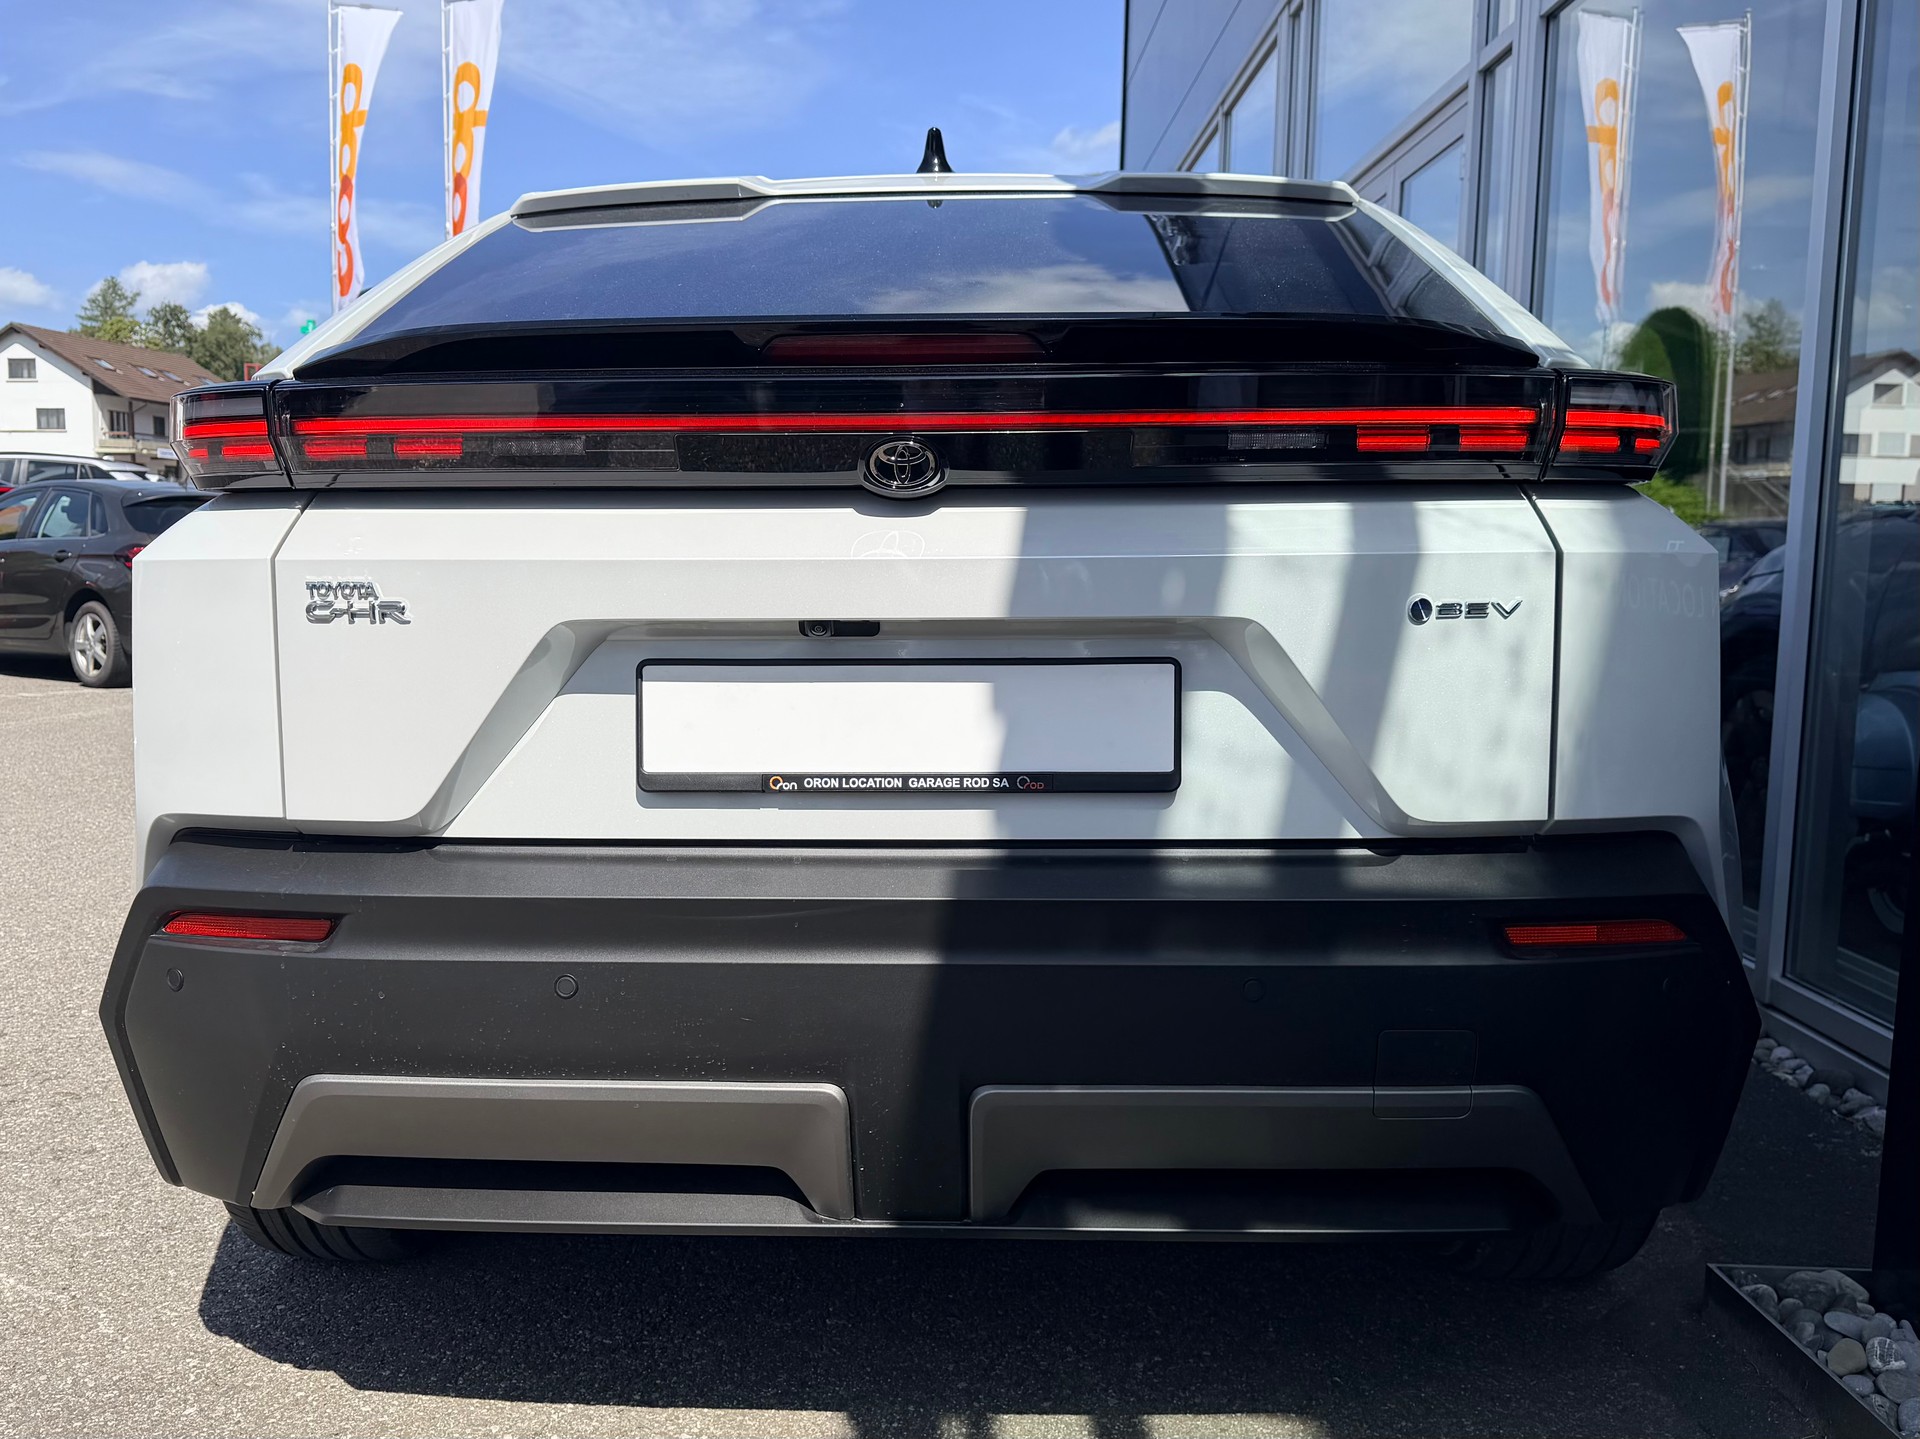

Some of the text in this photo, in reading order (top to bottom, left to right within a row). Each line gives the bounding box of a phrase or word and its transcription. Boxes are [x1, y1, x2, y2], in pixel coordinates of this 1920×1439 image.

[452, 61, 488, 237] oop
[338, 63, 368, 297] coop
[305, 580, 379, 600] TOYOTA
[305, 600, 411, 624] C-HR
[1435, 600, 1523, 620] BEV
[803, 777, 1010, 789] ORON LOCATION GARAGE ROD SA
